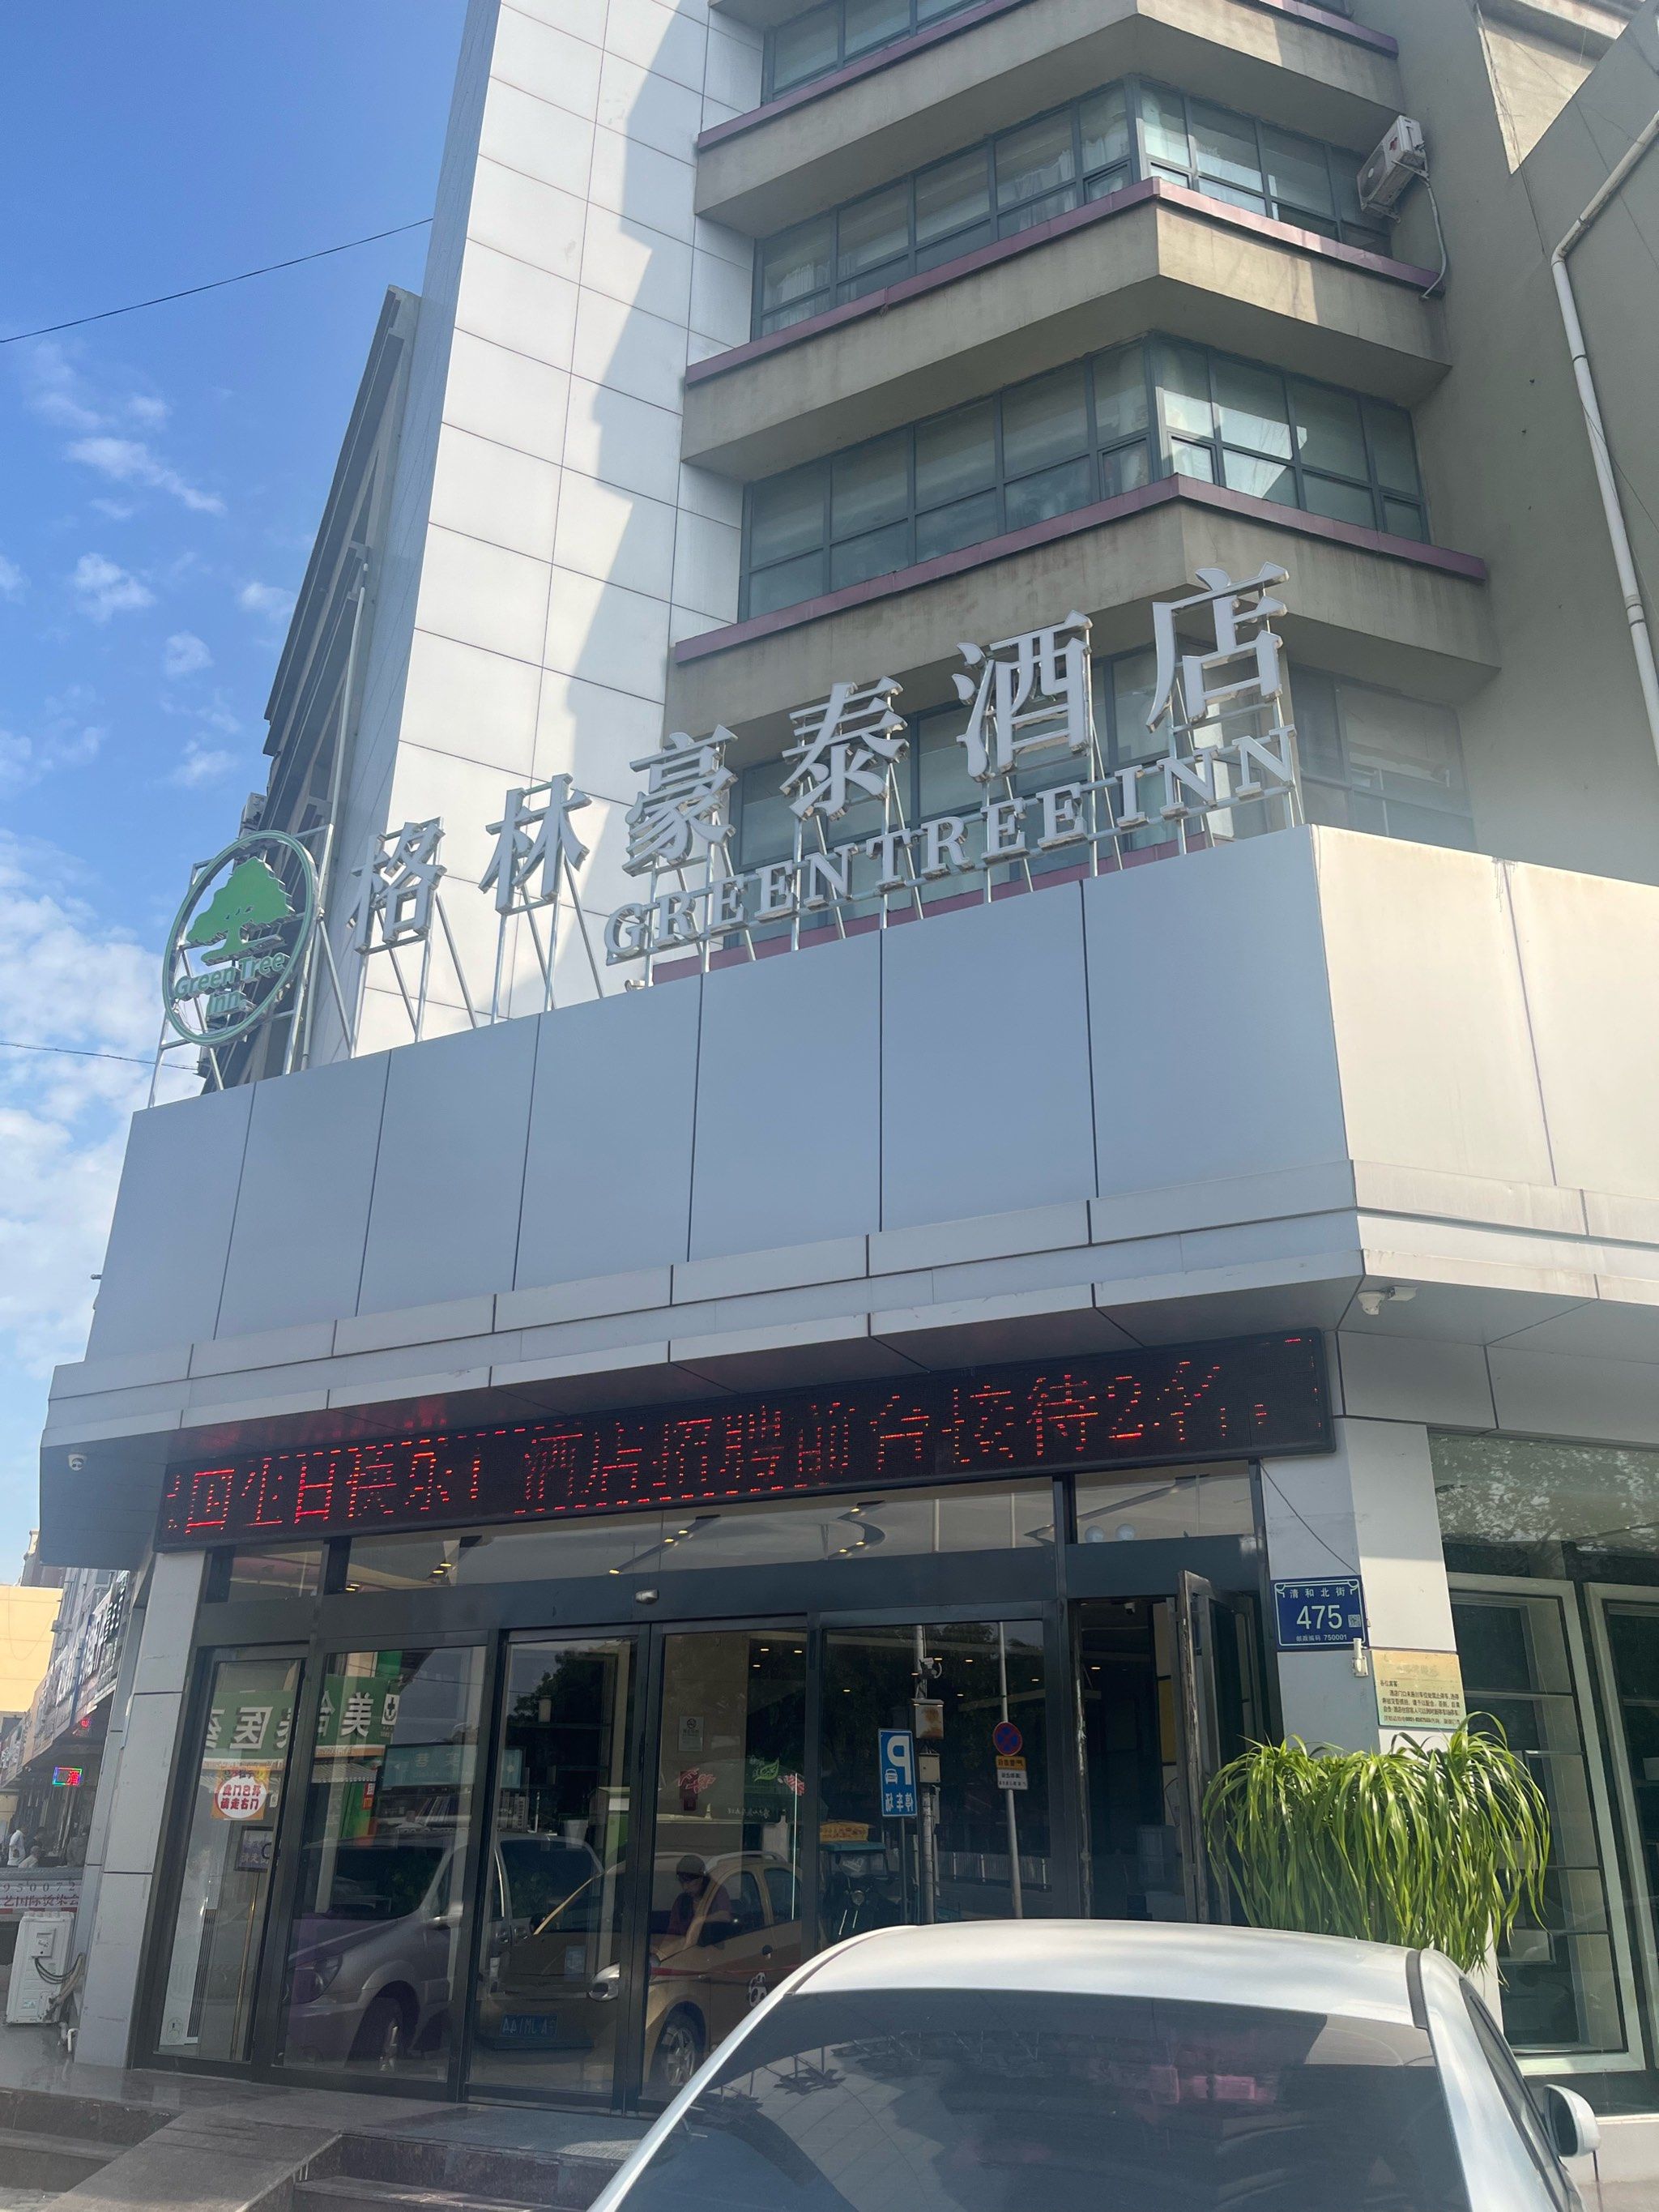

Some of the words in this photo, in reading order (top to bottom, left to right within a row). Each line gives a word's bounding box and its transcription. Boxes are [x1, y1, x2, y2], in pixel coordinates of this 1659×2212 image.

[345, 561, 1290, 954] 格林豪泰酒店
[174, 966, 237, 1000] Green
[238, 951, 288, 983] Tree
[206, 990, 243, 1017] Inn
[1289, 1586, 1346, 1599] 清和北街
[1296, 1604, 1343, 1629] 475
[222, 1784, 262, 1797] 此门已坏
[220, 1797, 260, 1810] 请走右门
